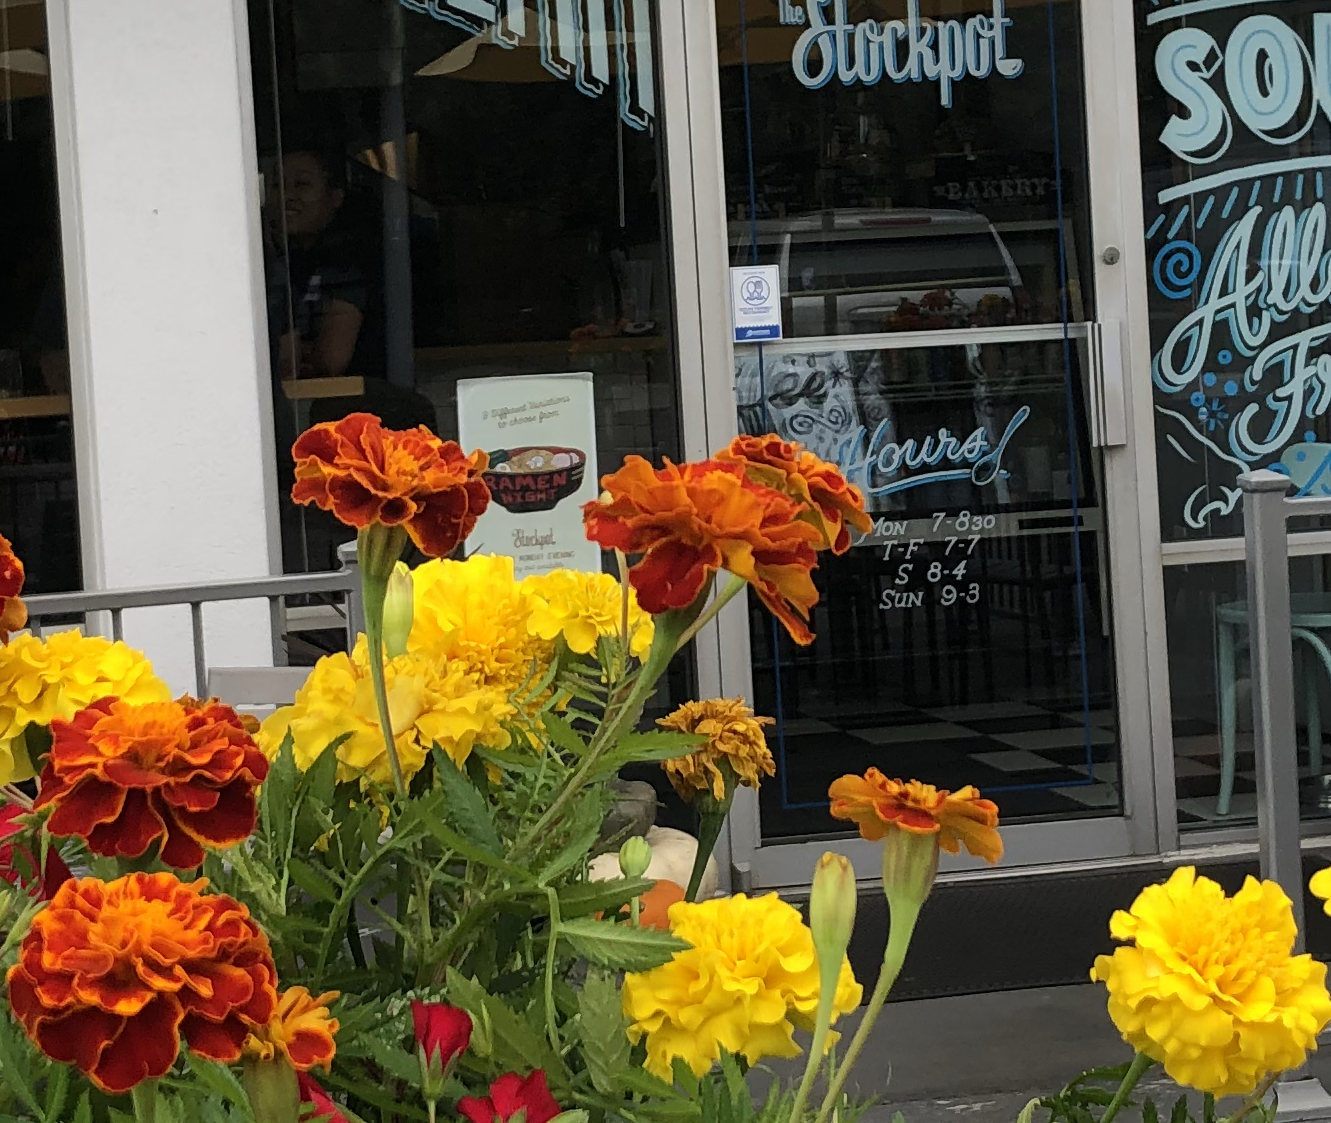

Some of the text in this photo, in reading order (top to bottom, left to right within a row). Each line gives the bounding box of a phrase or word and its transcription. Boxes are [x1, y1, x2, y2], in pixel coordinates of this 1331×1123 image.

[839, 418, 989, 487] Hours
[484, 471, 569, 491] RAMEN
[500, 488, 557, 504] NIGHT
[933, 510, 996, 533] 7-830
[882, 534, 981, 561] T-F 7-7
[894, 560, 967, 585] S 8-4
[878, 582, 980, 609] SUN 9-3
